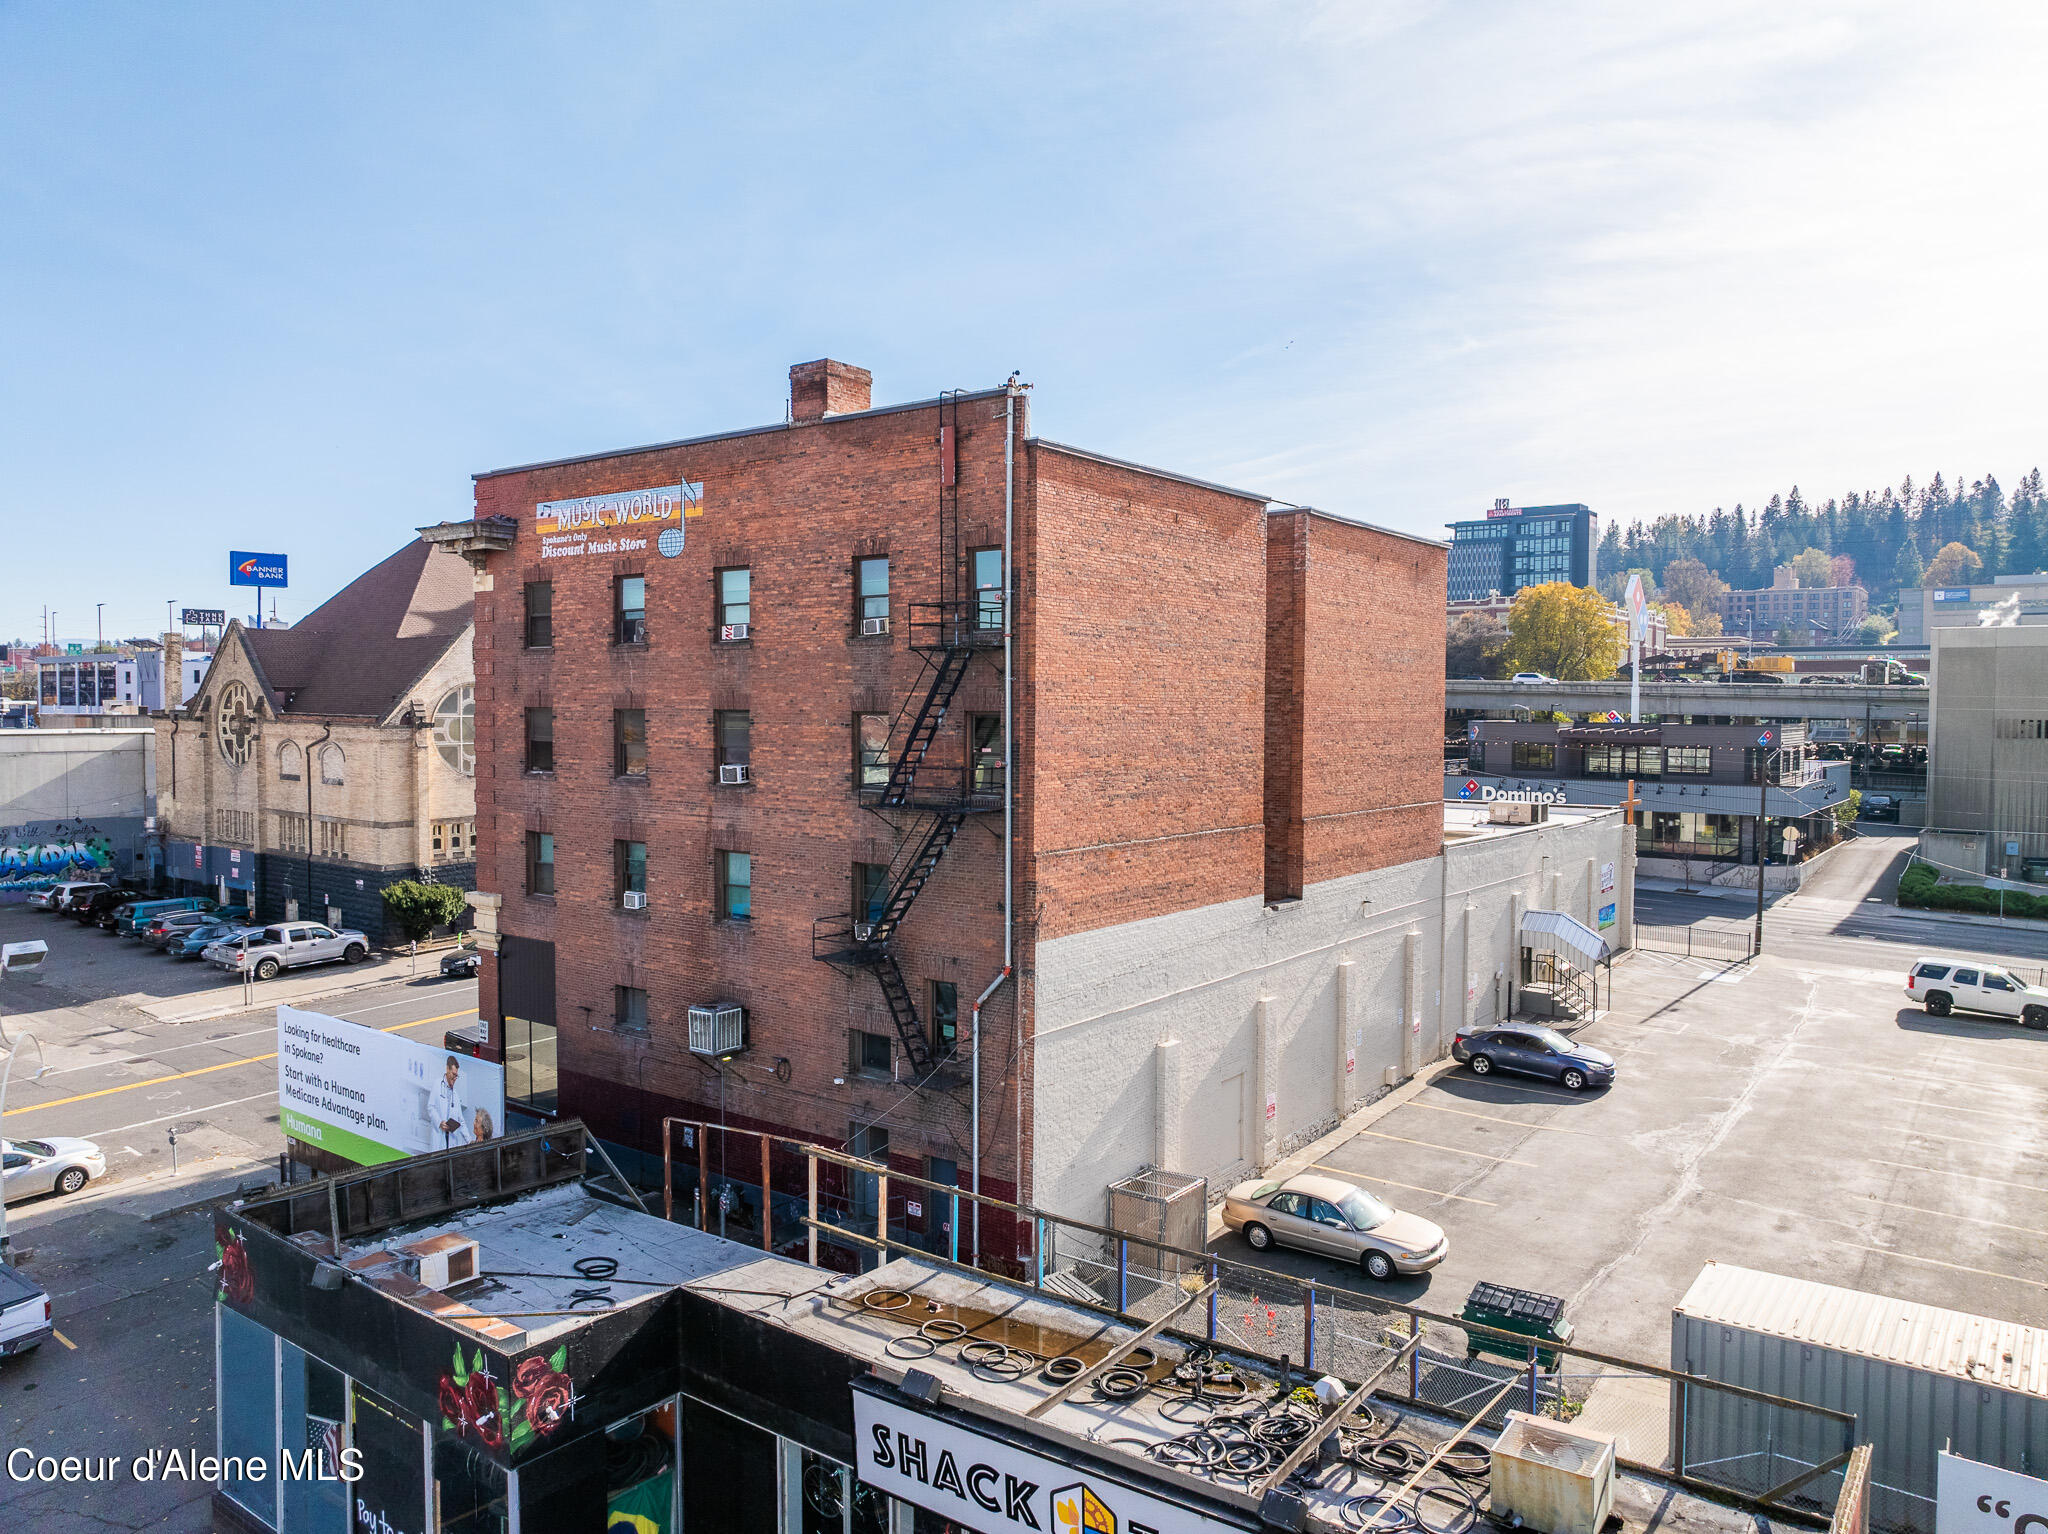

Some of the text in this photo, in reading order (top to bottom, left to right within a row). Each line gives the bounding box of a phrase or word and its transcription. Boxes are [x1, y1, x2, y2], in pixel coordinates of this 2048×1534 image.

[557, 492, 673, 531] MUSIC WORLD
[541, 538, 648, 558] Discount Music Store
[542, 533, 588, 545] Spokane's Only
[246, 565, 284, 574] BANNER
[1481, 785, 1567, 804] Domino's
[284, 1021, 361, 1056] Looking for healthcare
[284, 1041, 324, 1064] in Spokane?
[285, 1064, 365, 1103] Start with a Humana
[285, 1083, 389, 1131] Medicare Advantage plan.
[286, 1113, 322, 1140] Humana
[872, 1423, 1042, 1532] SHACK
